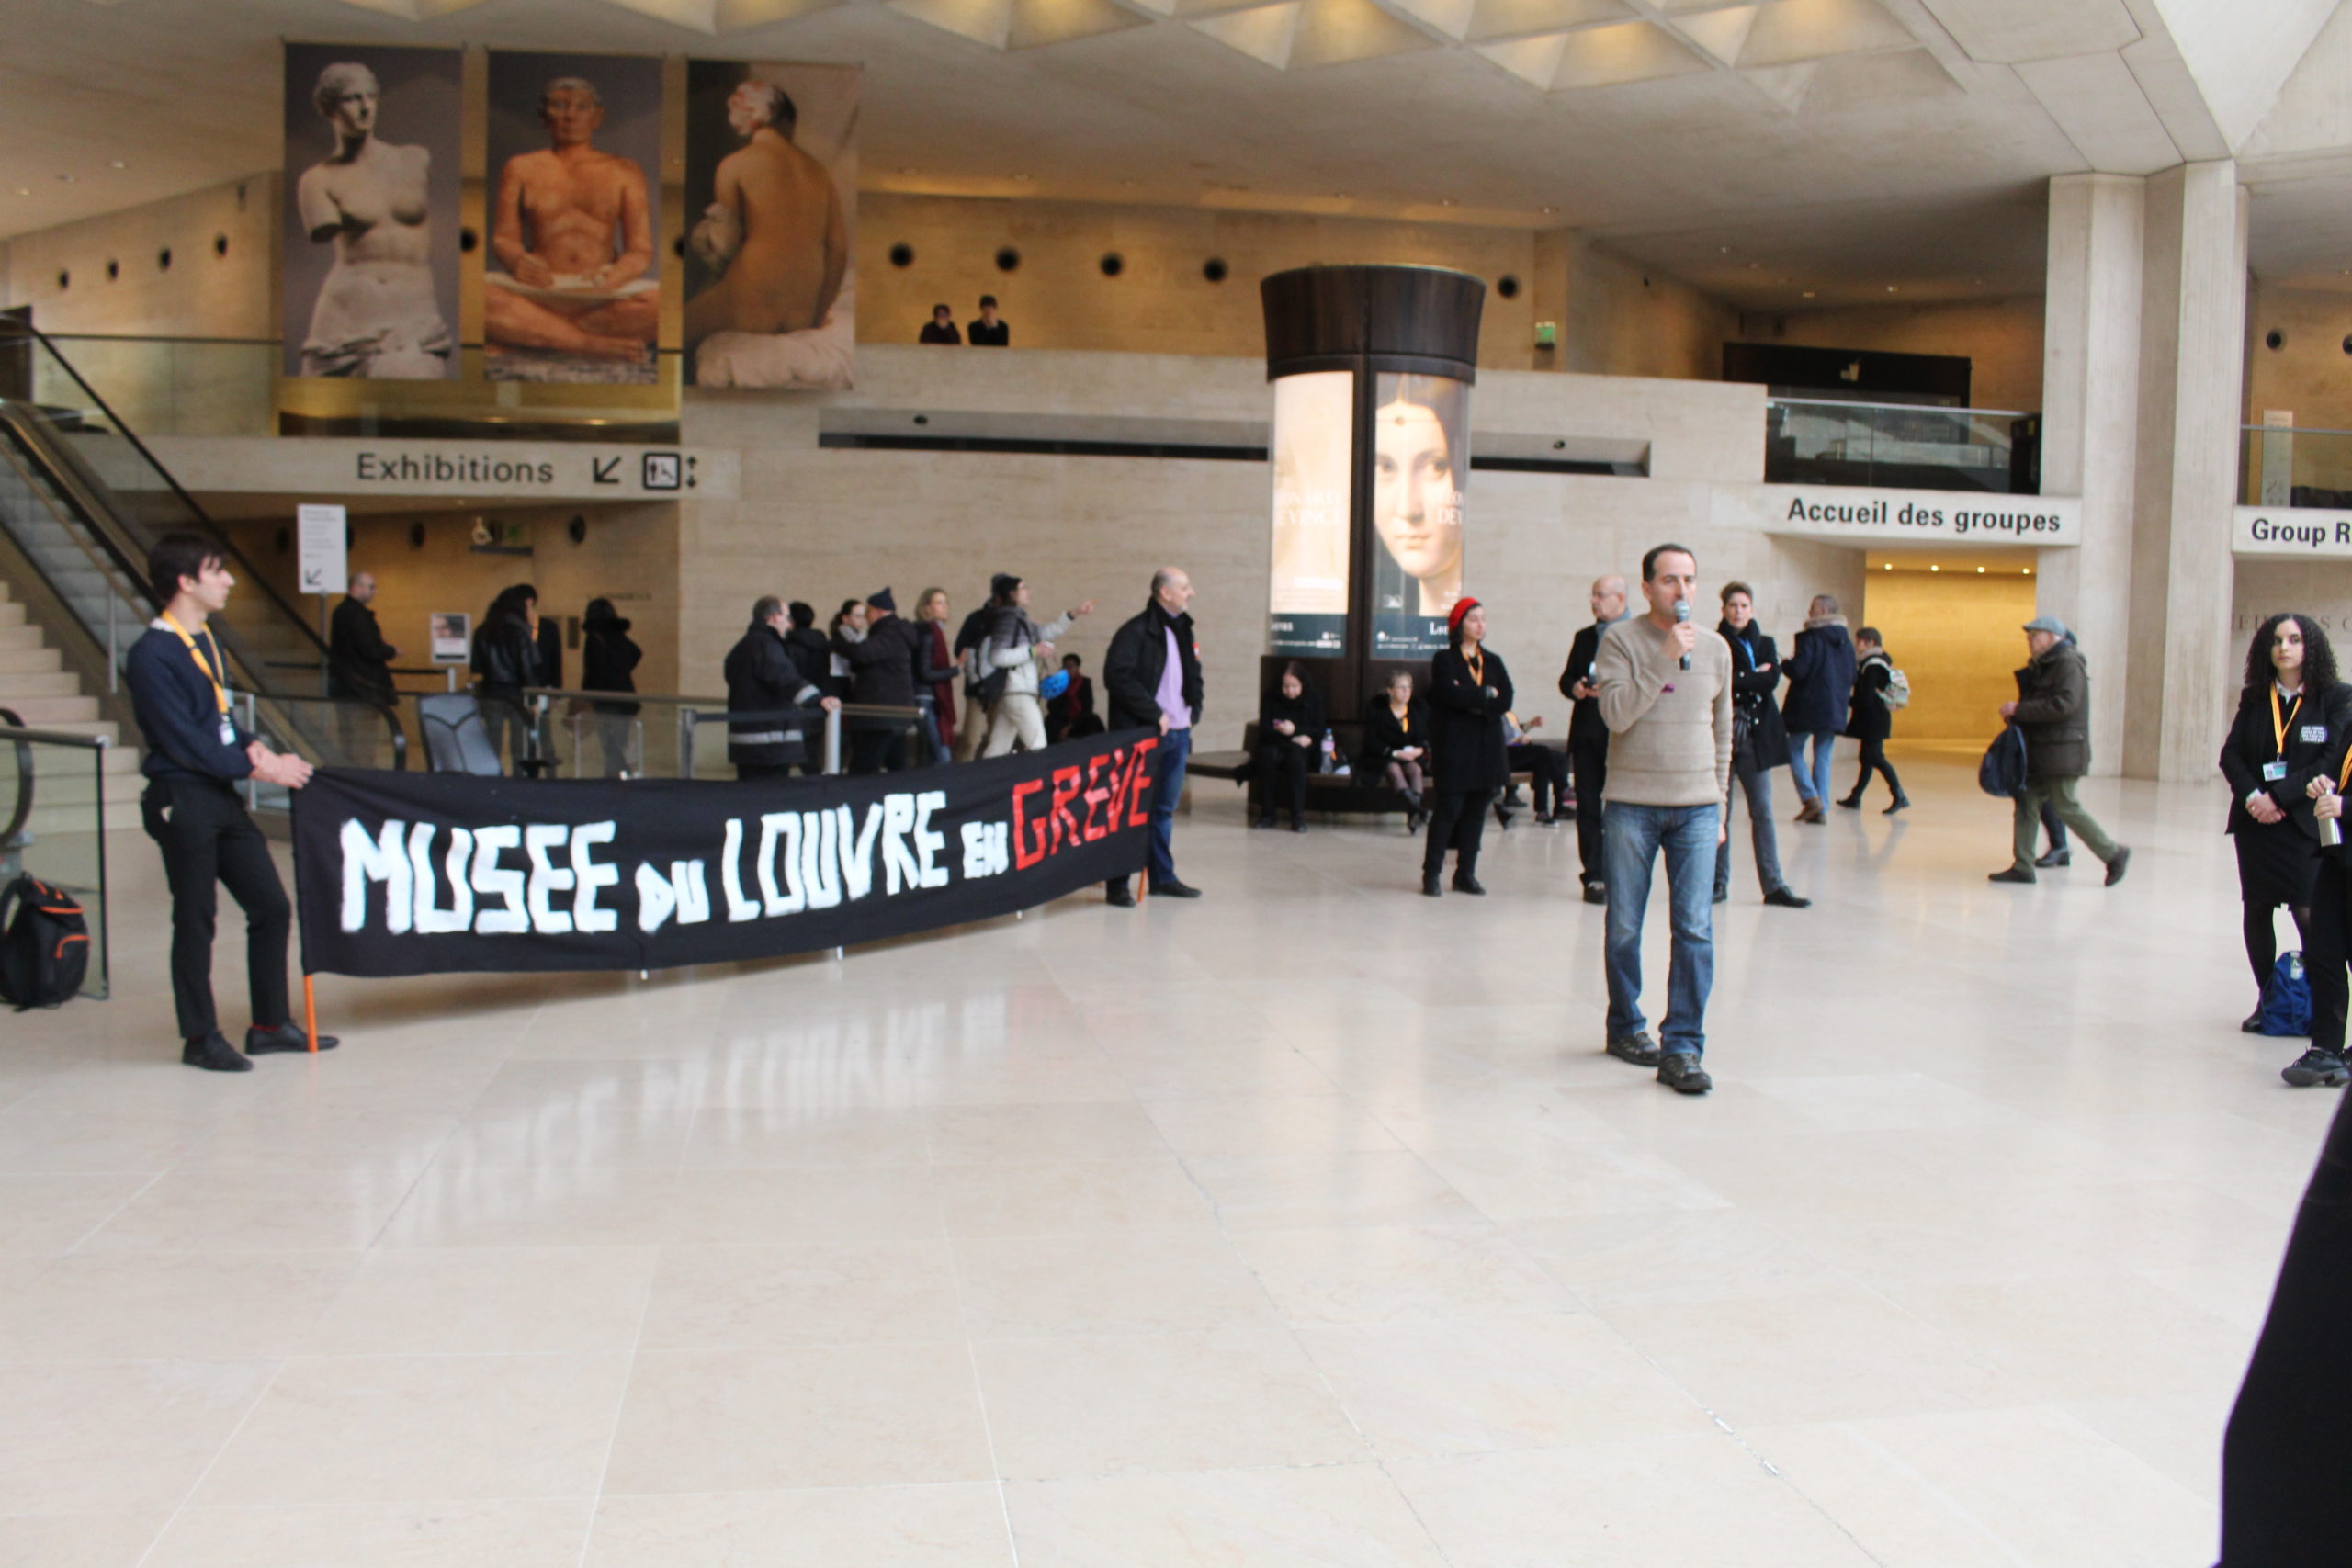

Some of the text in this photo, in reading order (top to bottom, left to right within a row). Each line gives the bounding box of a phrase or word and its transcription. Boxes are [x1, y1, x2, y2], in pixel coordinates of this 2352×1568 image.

[356, 451, 554, 484] Exhibitions
[1787, 497, 2061, 536] Accueil des groupes
[2251, 518, 2327, 548] Group
[340, 737, 1159, 935] MUSEE DU LOUVRE EN GREVE
